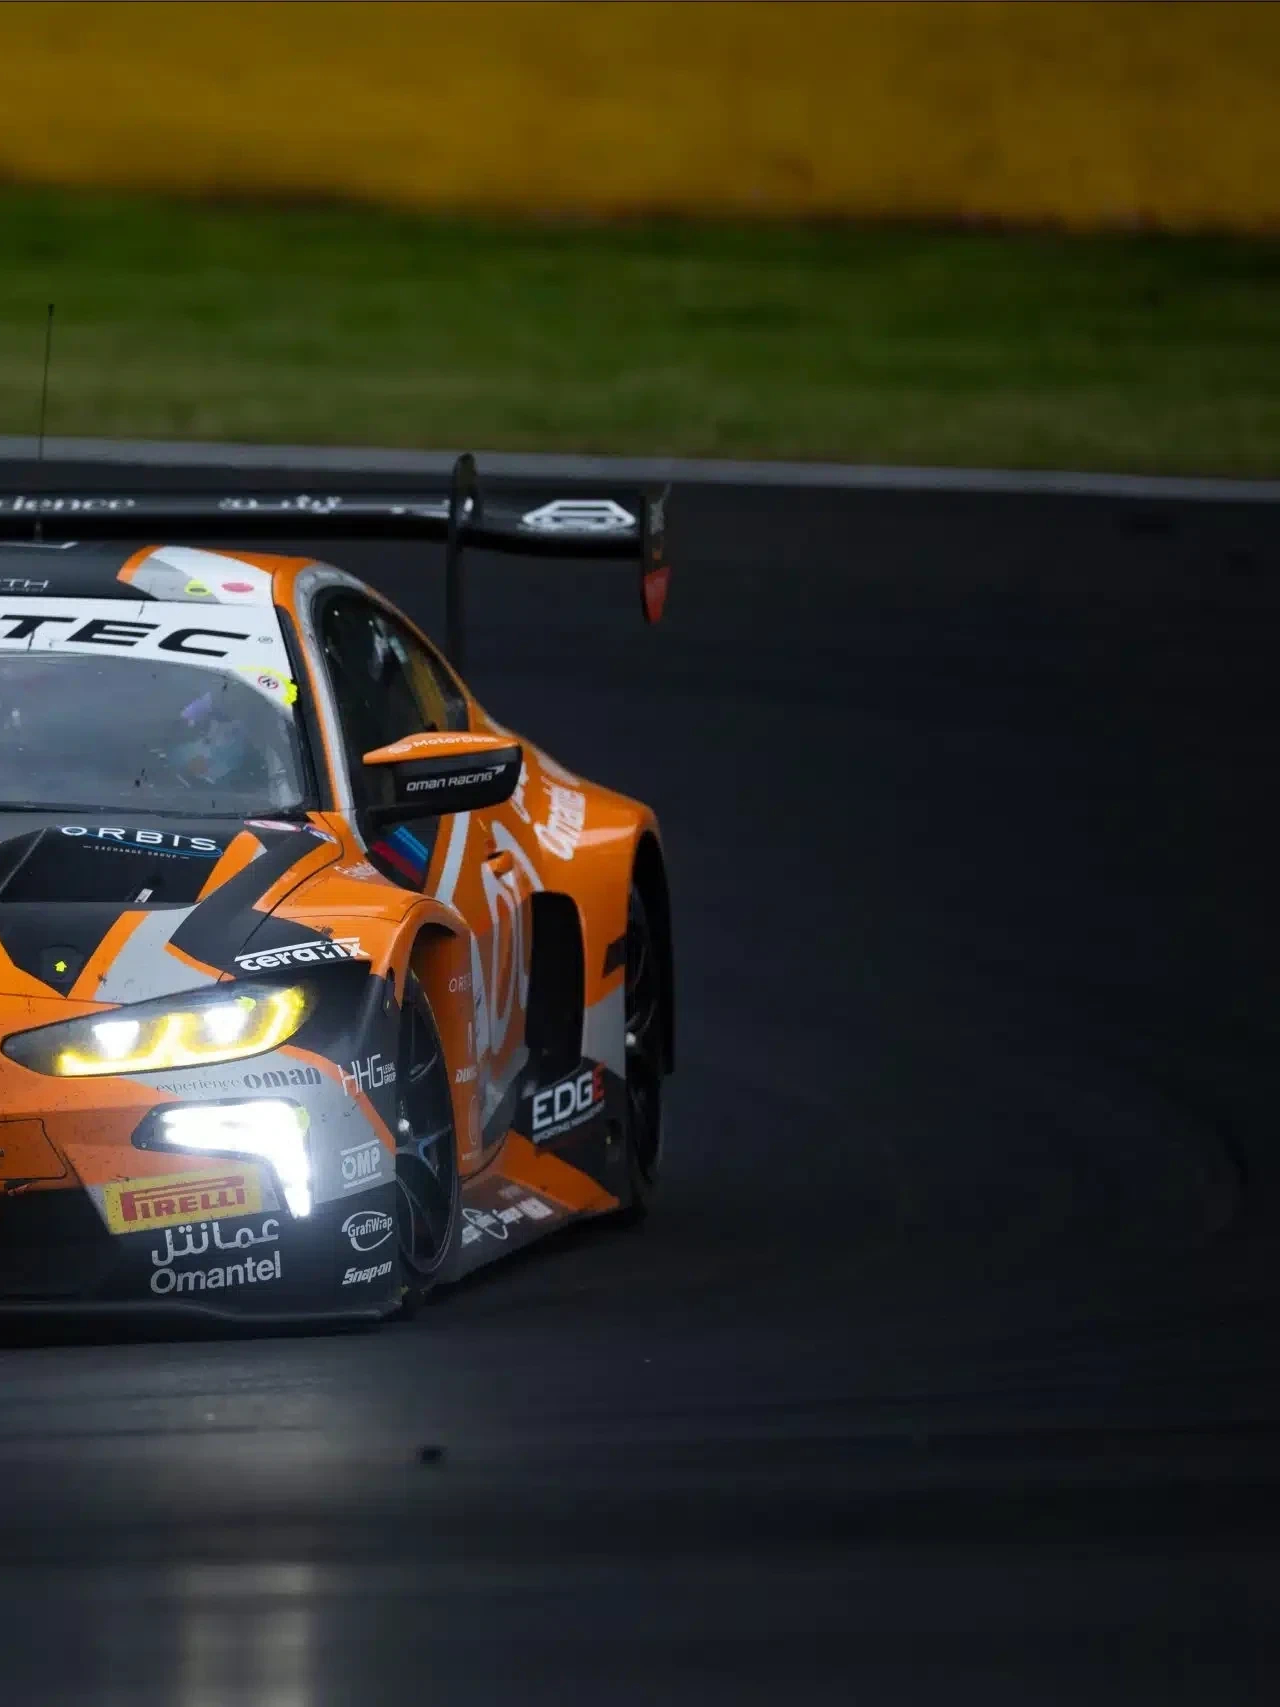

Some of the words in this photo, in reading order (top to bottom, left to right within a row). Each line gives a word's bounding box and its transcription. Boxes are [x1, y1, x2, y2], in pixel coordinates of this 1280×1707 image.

[61, 826, 217, 851] ORBIS
[156, 1078, 241, 1094] experience
[242, 1067, 322, 1089] oman
[337, 1053, 384, 1097] HHG
[532, 1063, 605, 1130] EDGE
[341, 1147, 381, 1180] OMP
[120, 1175, 245, 1222] PIRELLI
[151, 1218, 280, 1267] عمانتل
[347, 1216, 393, 1239] GrafiWrap
[150, 1251, 282, 1295] Omantel
[342, 1261, 393, 1285] Snap-on
